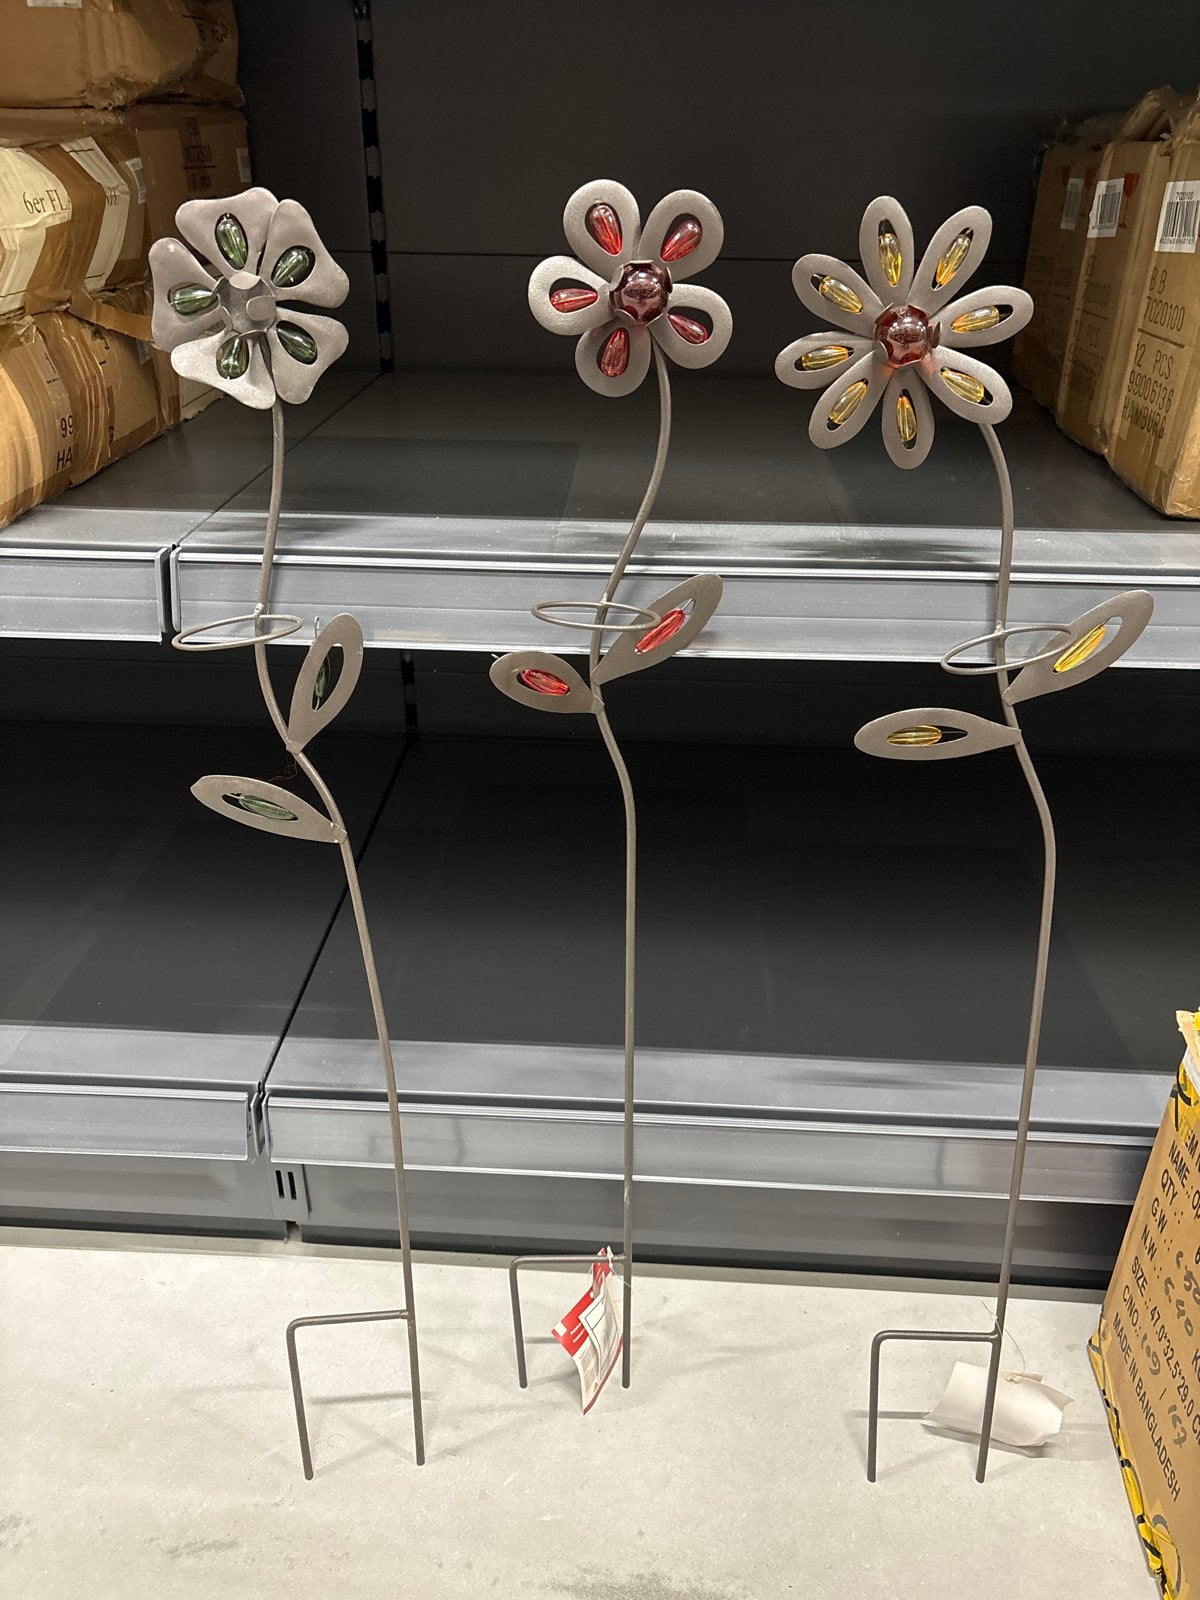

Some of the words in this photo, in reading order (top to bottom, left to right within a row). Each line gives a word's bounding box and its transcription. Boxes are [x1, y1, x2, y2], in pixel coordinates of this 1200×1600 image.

[23, 191, 46, 214] 6er
[46, 189, 70, 212] FL
[1143, 296, 1186, 332] 7020100
[1133, 342, 1146, 368] 12
[1152, 349, 1174, 380] PCS
[1127, 370, 1174, 413] 99006136
[1122, 396, 1167, 440] HAMBURG
[1168, 1140, 1190, 1189] NAME
[1161, 1168, 1178, 1206] QTY
[1131, 1255, 1148, 1298] SIZE
[1113, 1311, 1132, 1364] MADE
[1128, 1357, 1139, 1383] IN
[1135, 1376, 1181, 1502] BANGLADESH
